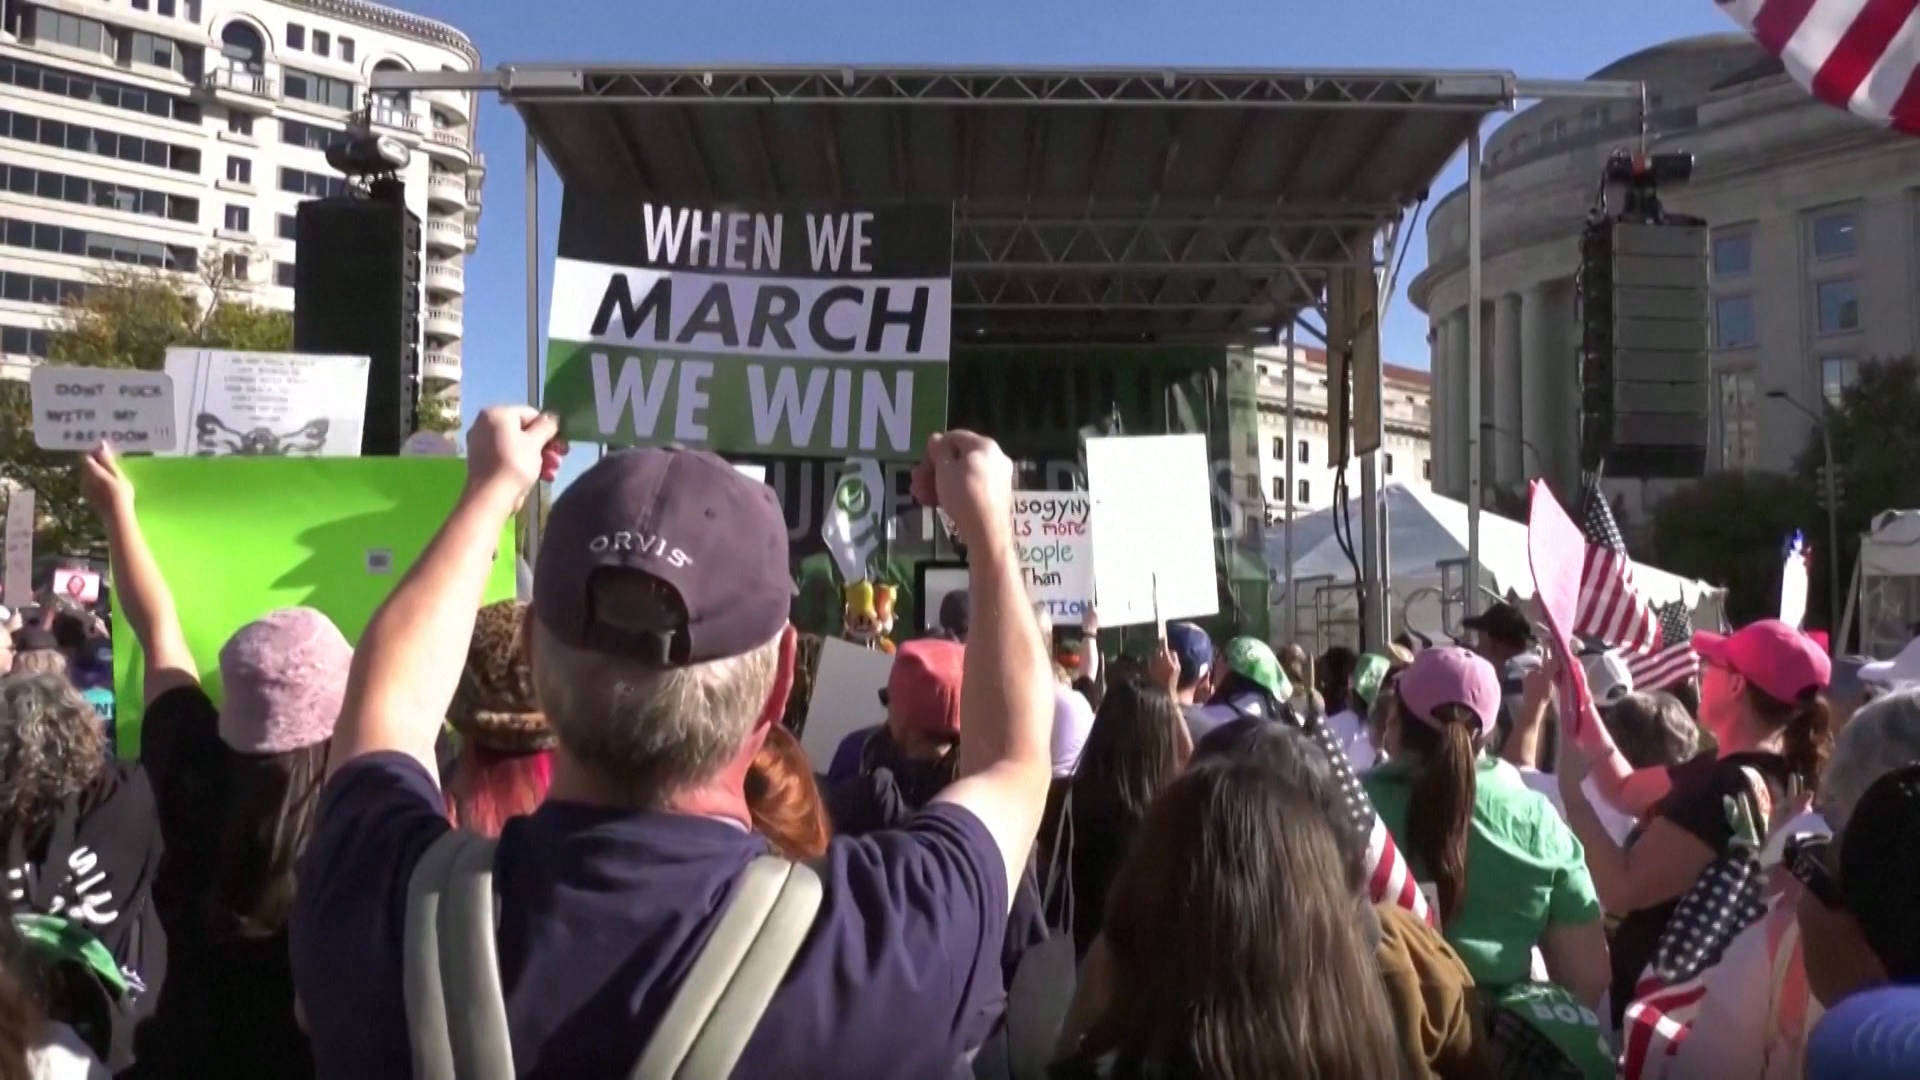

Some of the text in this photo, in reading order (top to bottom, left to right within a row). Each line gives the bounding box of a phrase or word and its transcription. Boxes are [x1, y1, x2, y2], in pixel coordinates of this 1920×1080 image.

[643, 202, 875, 272] WHEN WE
[590, 273, 930, 353] MARCH
[591, 352, 914, 452] WE WIN
[589, 530, 691, 568] ORVIS
